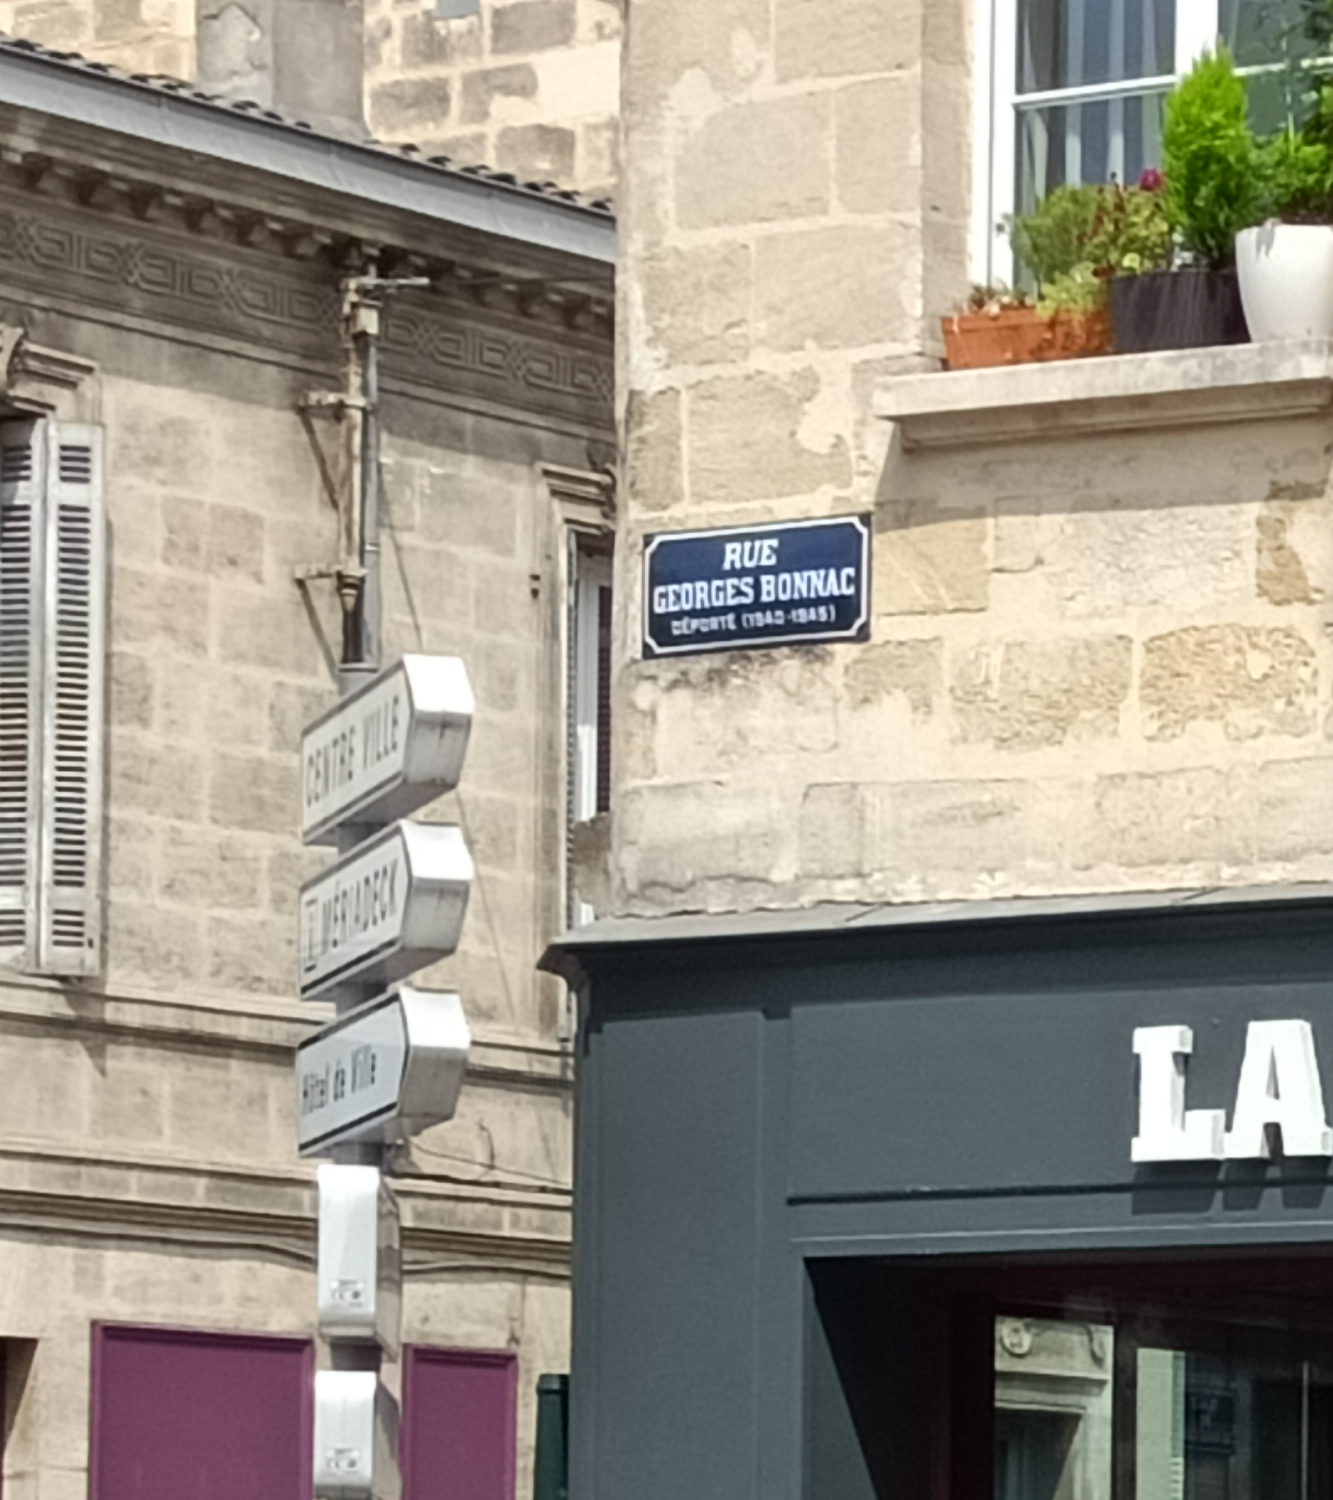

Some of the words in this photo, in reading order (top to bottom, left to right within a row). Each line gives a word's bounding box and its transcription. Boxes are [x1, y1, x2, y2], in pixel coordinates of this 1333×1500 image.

[722, 538, 779, 570] RUE
[652, 576, 755, 614] GEORGES
[760, 566, 856, 603] BONNAC
[305, 723, 356, 808] CENTRE
[362, 694, 399, 771] VILLE
[333, 1057, 346, 1102] de
[351, 1044, 377, 1094] Ville
